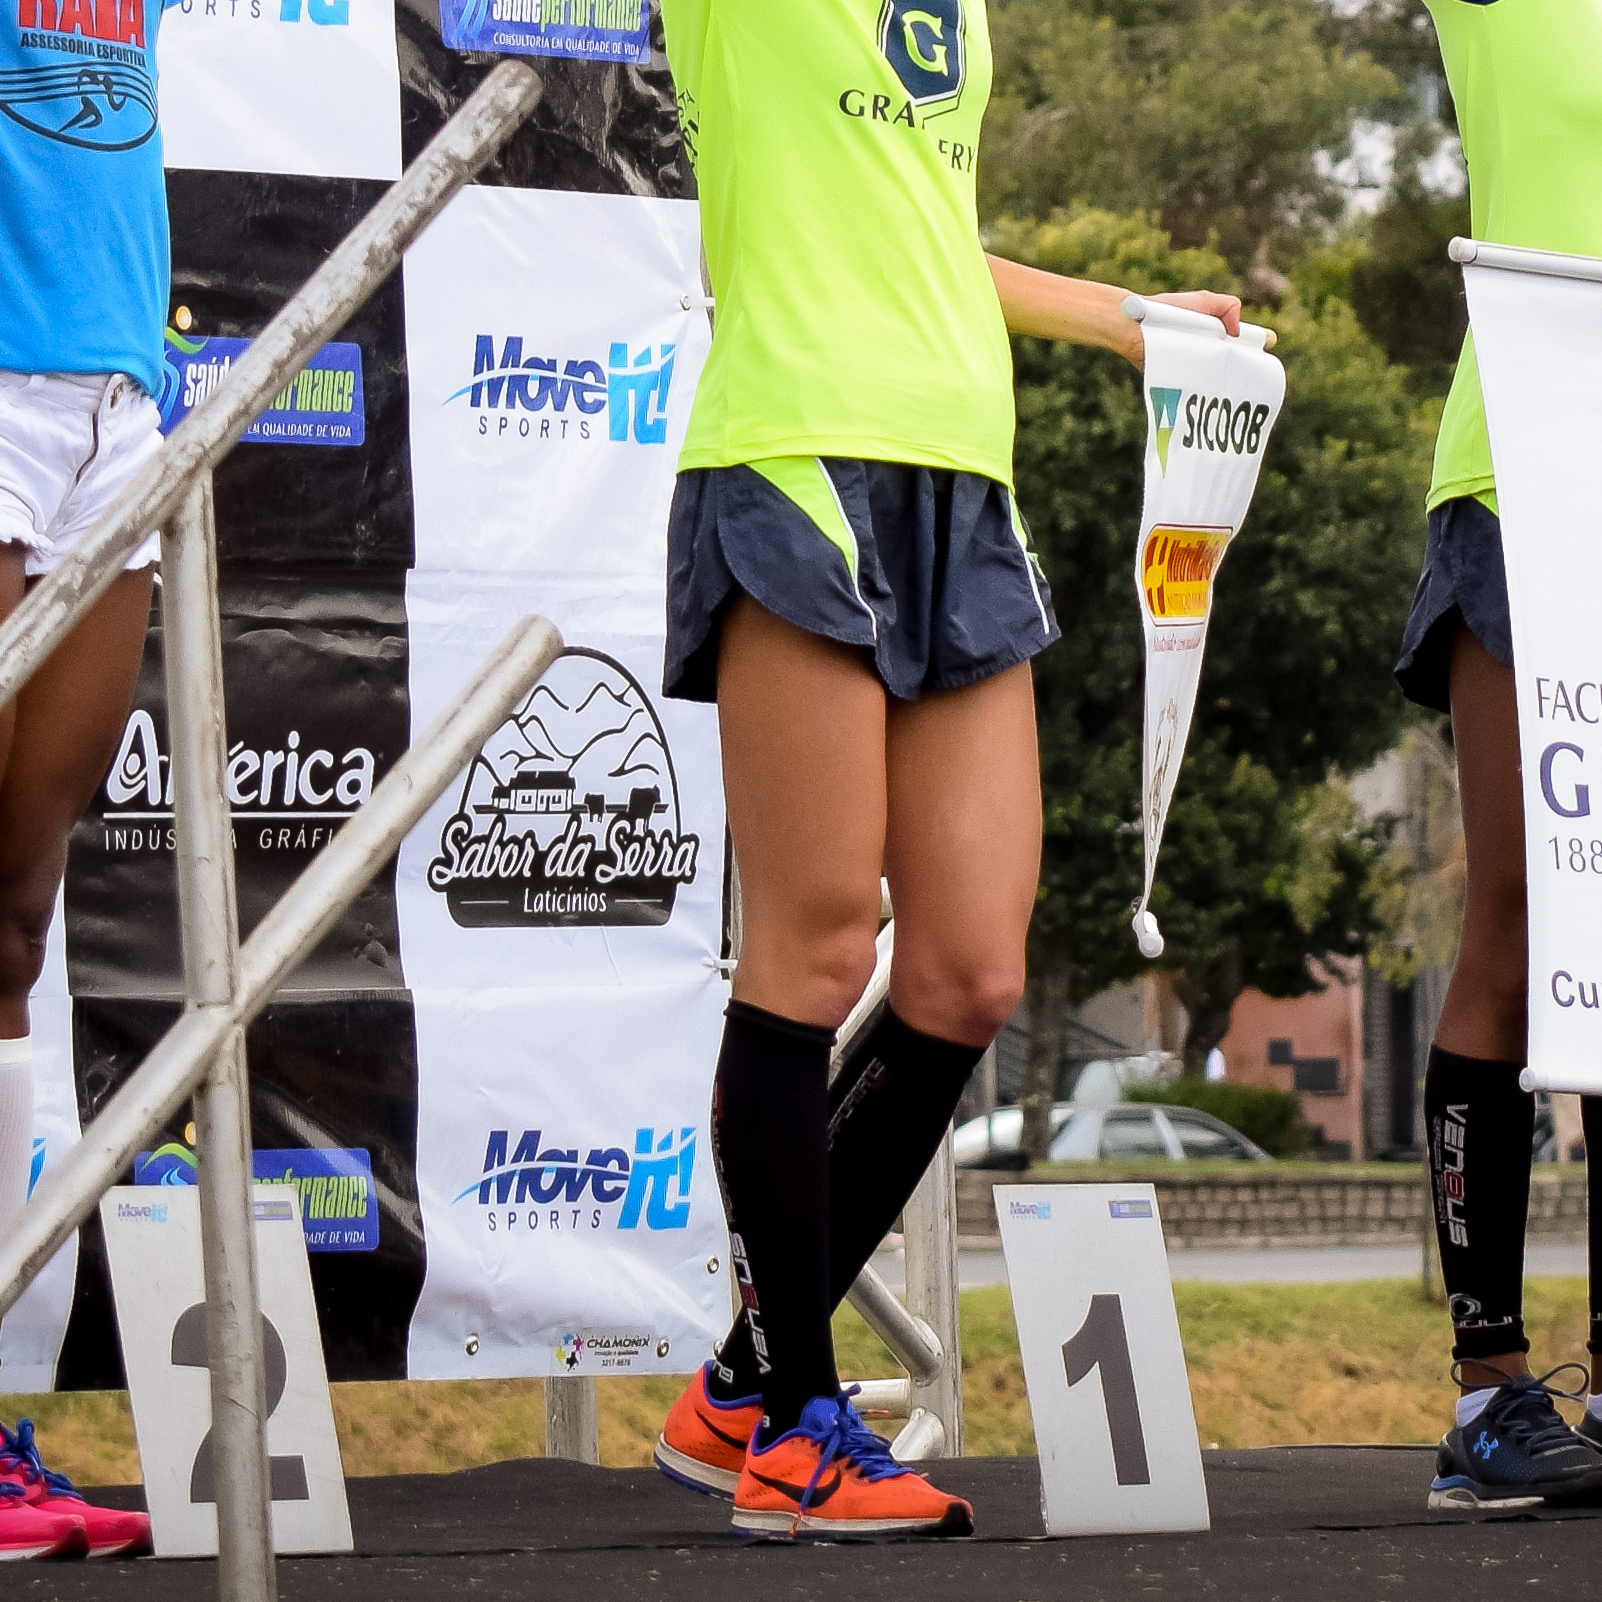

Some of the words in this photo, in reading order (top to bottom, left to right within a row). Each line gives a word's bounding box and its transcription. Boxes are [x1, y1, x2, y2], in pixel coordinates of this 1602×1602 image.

[902, 9, 949, 76] G
[262, 421, 315, 438] QUALIDADE
[316, 425, 328, 438] DE
[330, 425, 351, 438] VIDA
[479, 415, 591, 441] SPORTS
[1183, 394, 1270, 456] SICOOB
[107, 709, 375, 805] Aérica
[432, 821, 537, 882] Sabor
[545, 829, 592, 880] da
[596, 827, 700, 883] Serra
[523, 885, 608, 913] Laticínios
[487, 1208, 602, 1232] SPORTS
[329, 1230, 341, 1244] DE
[345, 1230, 365, 1244] VIDA
[586, 1335, 651, 1349] CHAMONIX
[1061, 1294, 1152, 1487] 1
